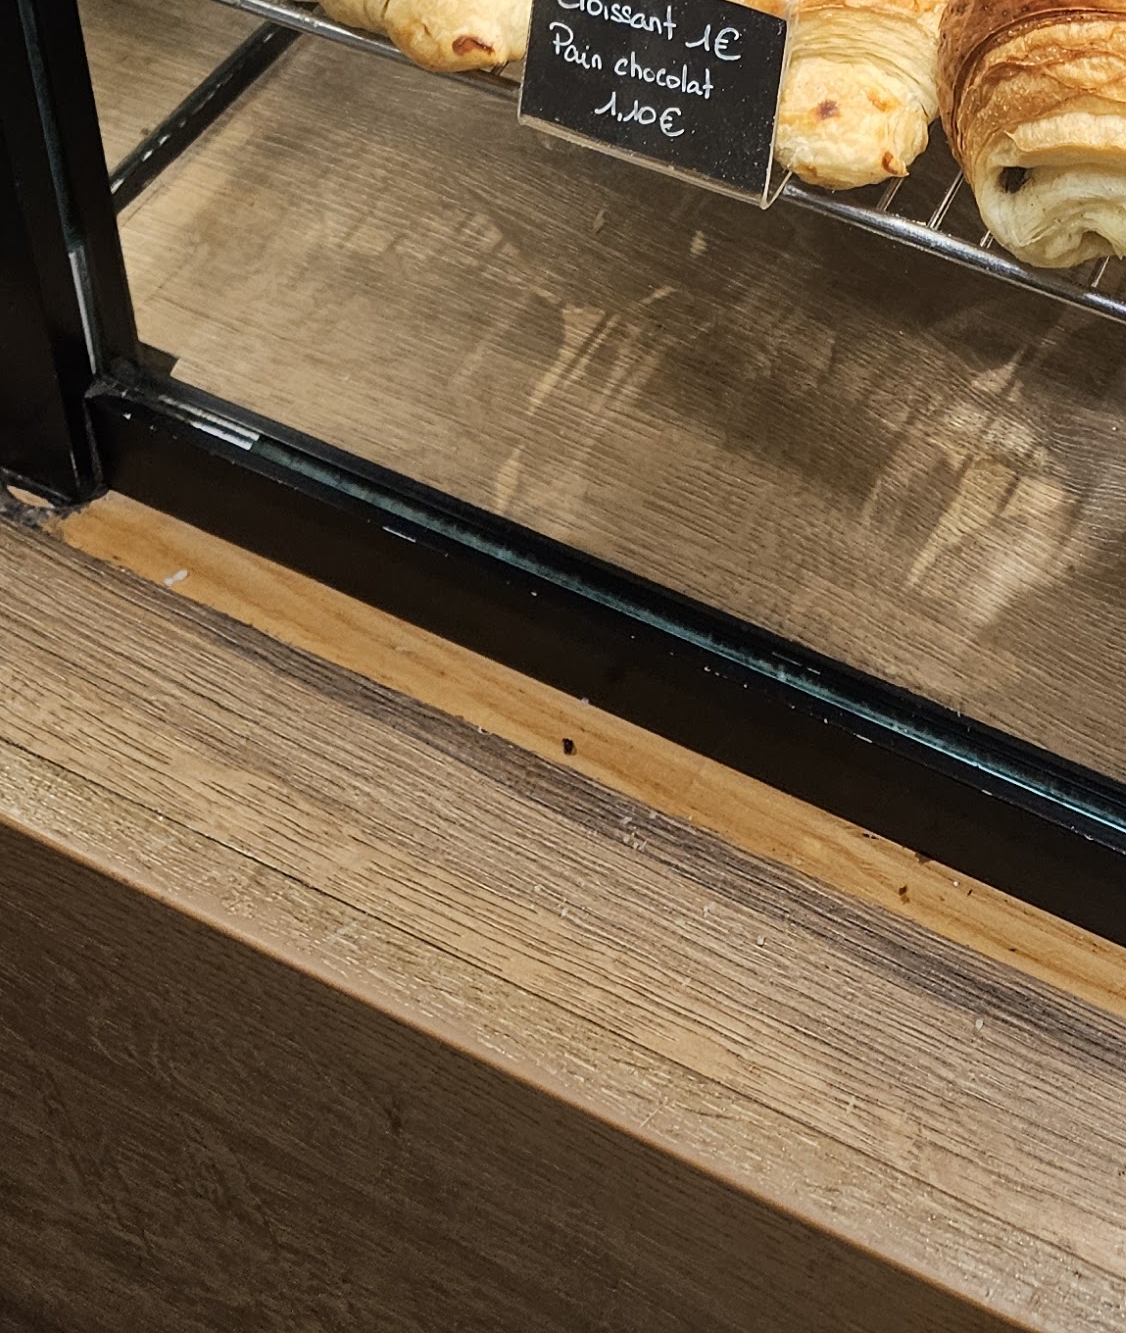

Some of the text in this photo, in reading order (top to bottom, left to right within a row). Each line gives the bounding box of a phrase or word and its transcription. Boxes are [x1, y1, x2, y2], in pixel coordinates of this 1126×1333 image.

[549, 21, 714, 100] Pain chocolat
[685, 23, 742, 61] 1€
